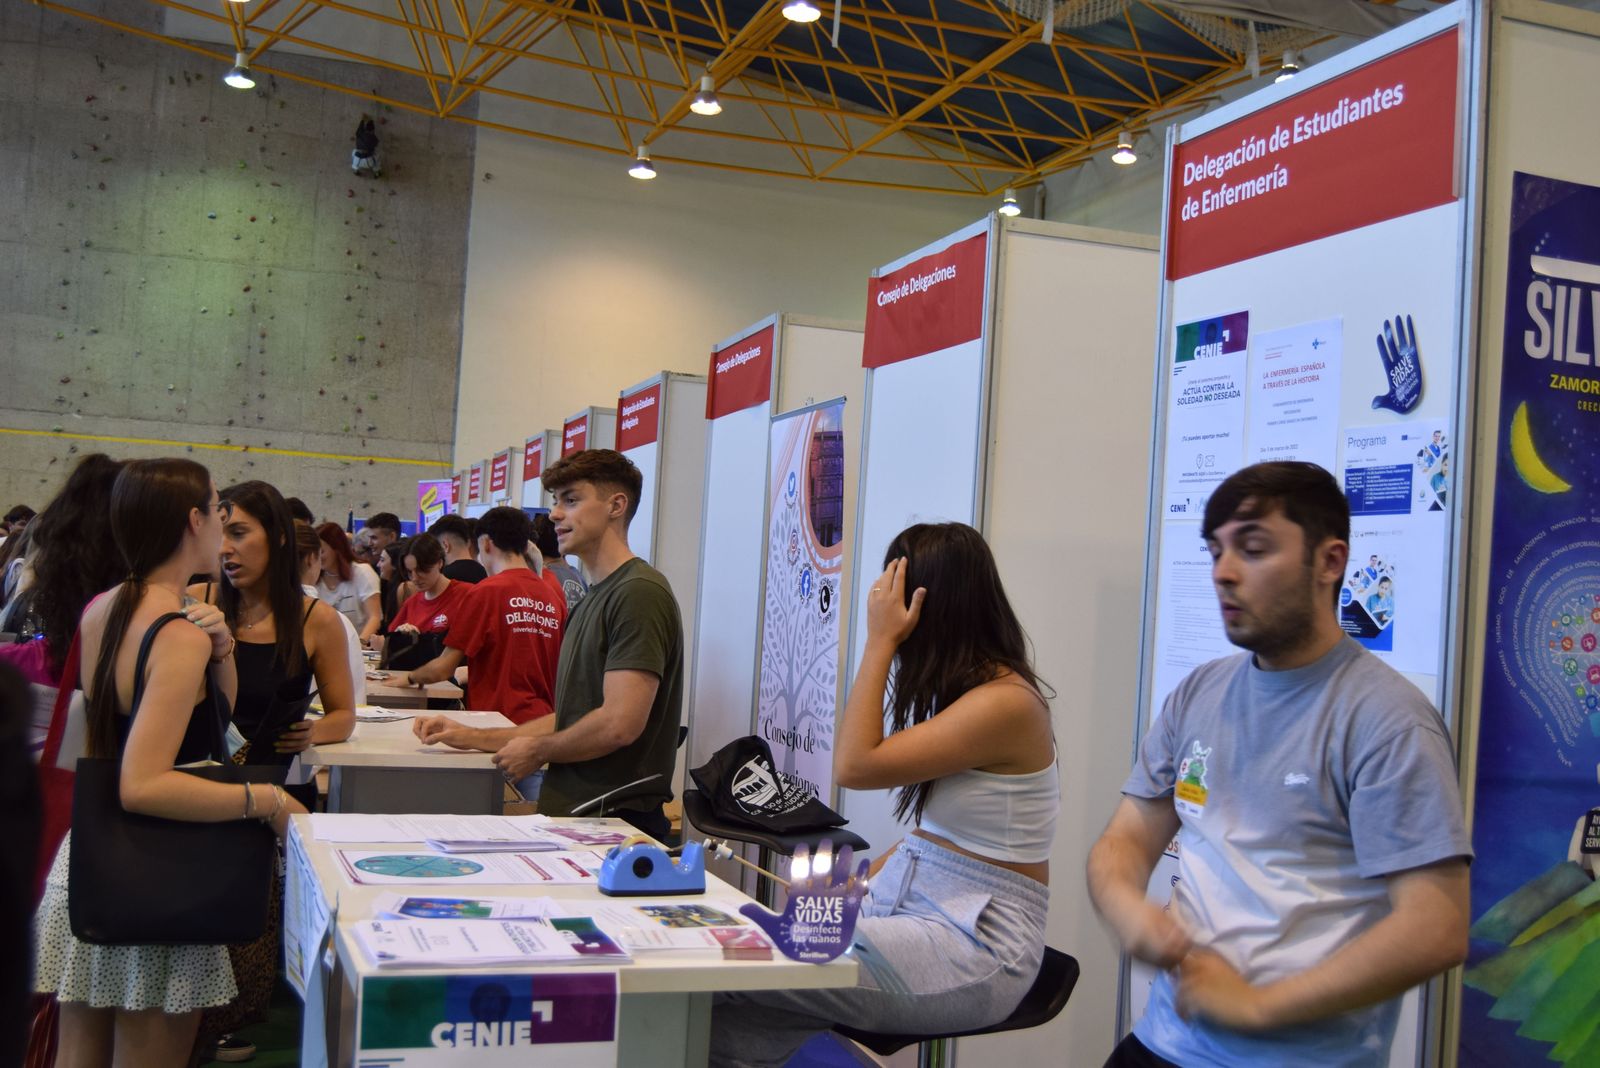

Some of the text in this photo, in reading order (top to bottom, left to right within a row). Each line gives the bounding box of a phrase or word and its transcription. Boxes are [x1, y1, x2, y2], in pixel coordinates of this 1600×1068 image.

[1183, 82, 1404, 187] Delegación de Estudiantes
[1181, 164, 1288, 222] de Enfermería
[877, 264, 956, 307] Consejo de Delegaciones
[1193, 342, 1223, 360] CENIE
[1301, 362, 1326, 373] ESPAÑOLA
[1390, 352, 1412, 379] SALVE
[1298, 374, 1320, 384] HISTORIA
[1392, 363, 1414, 388] VIDAS
[1202, 382, 1226, 393] CONTRA
[1227, 380, 1235, 389] LA
[1176, 389, 1241, 406] SOLEDAD NO DESEADA
[1347, 436, 1387, 450] Programa
[1170, 504, 1187, 512] CENIE
[509, 597, 556, 613] CONSJO de
[764, 718, 815, 754] Consejo de
[796, 896, 843, 910] SALVE
[795, 909, 843, 923] VIDAS
[793, 922, 842, 935] Desinfecte
[793, 934, 806, 943] las
[431, 1021, 532, 1049] CENIE
